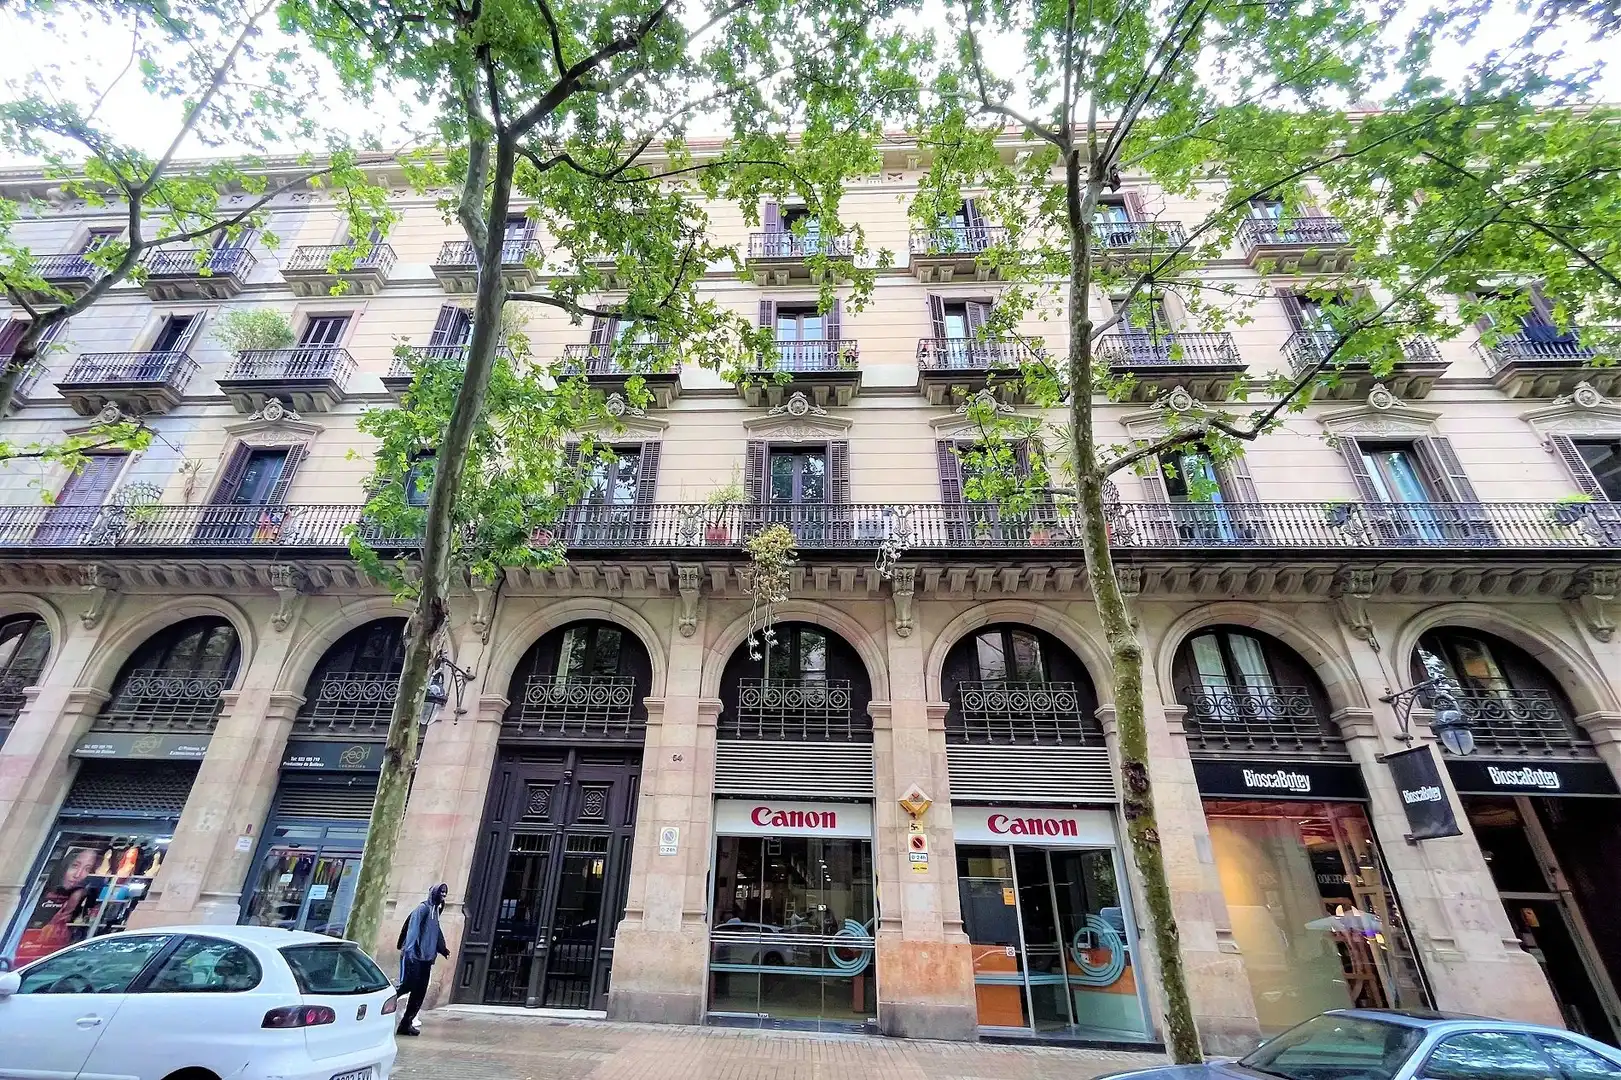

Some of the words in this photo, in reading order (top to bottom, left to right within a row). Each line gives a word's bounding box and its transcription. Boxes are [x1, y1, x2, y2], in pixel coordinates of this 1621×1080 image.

[1242, 769, 1311, 792] BioscaBotey
[1487, 766, 1560, 789] BioscaBotey
[1402, 785, 1442, 804] BioscaBotey
[751, 806, 836, 828] Canon
[987, 814, 1078, 836] Canon
